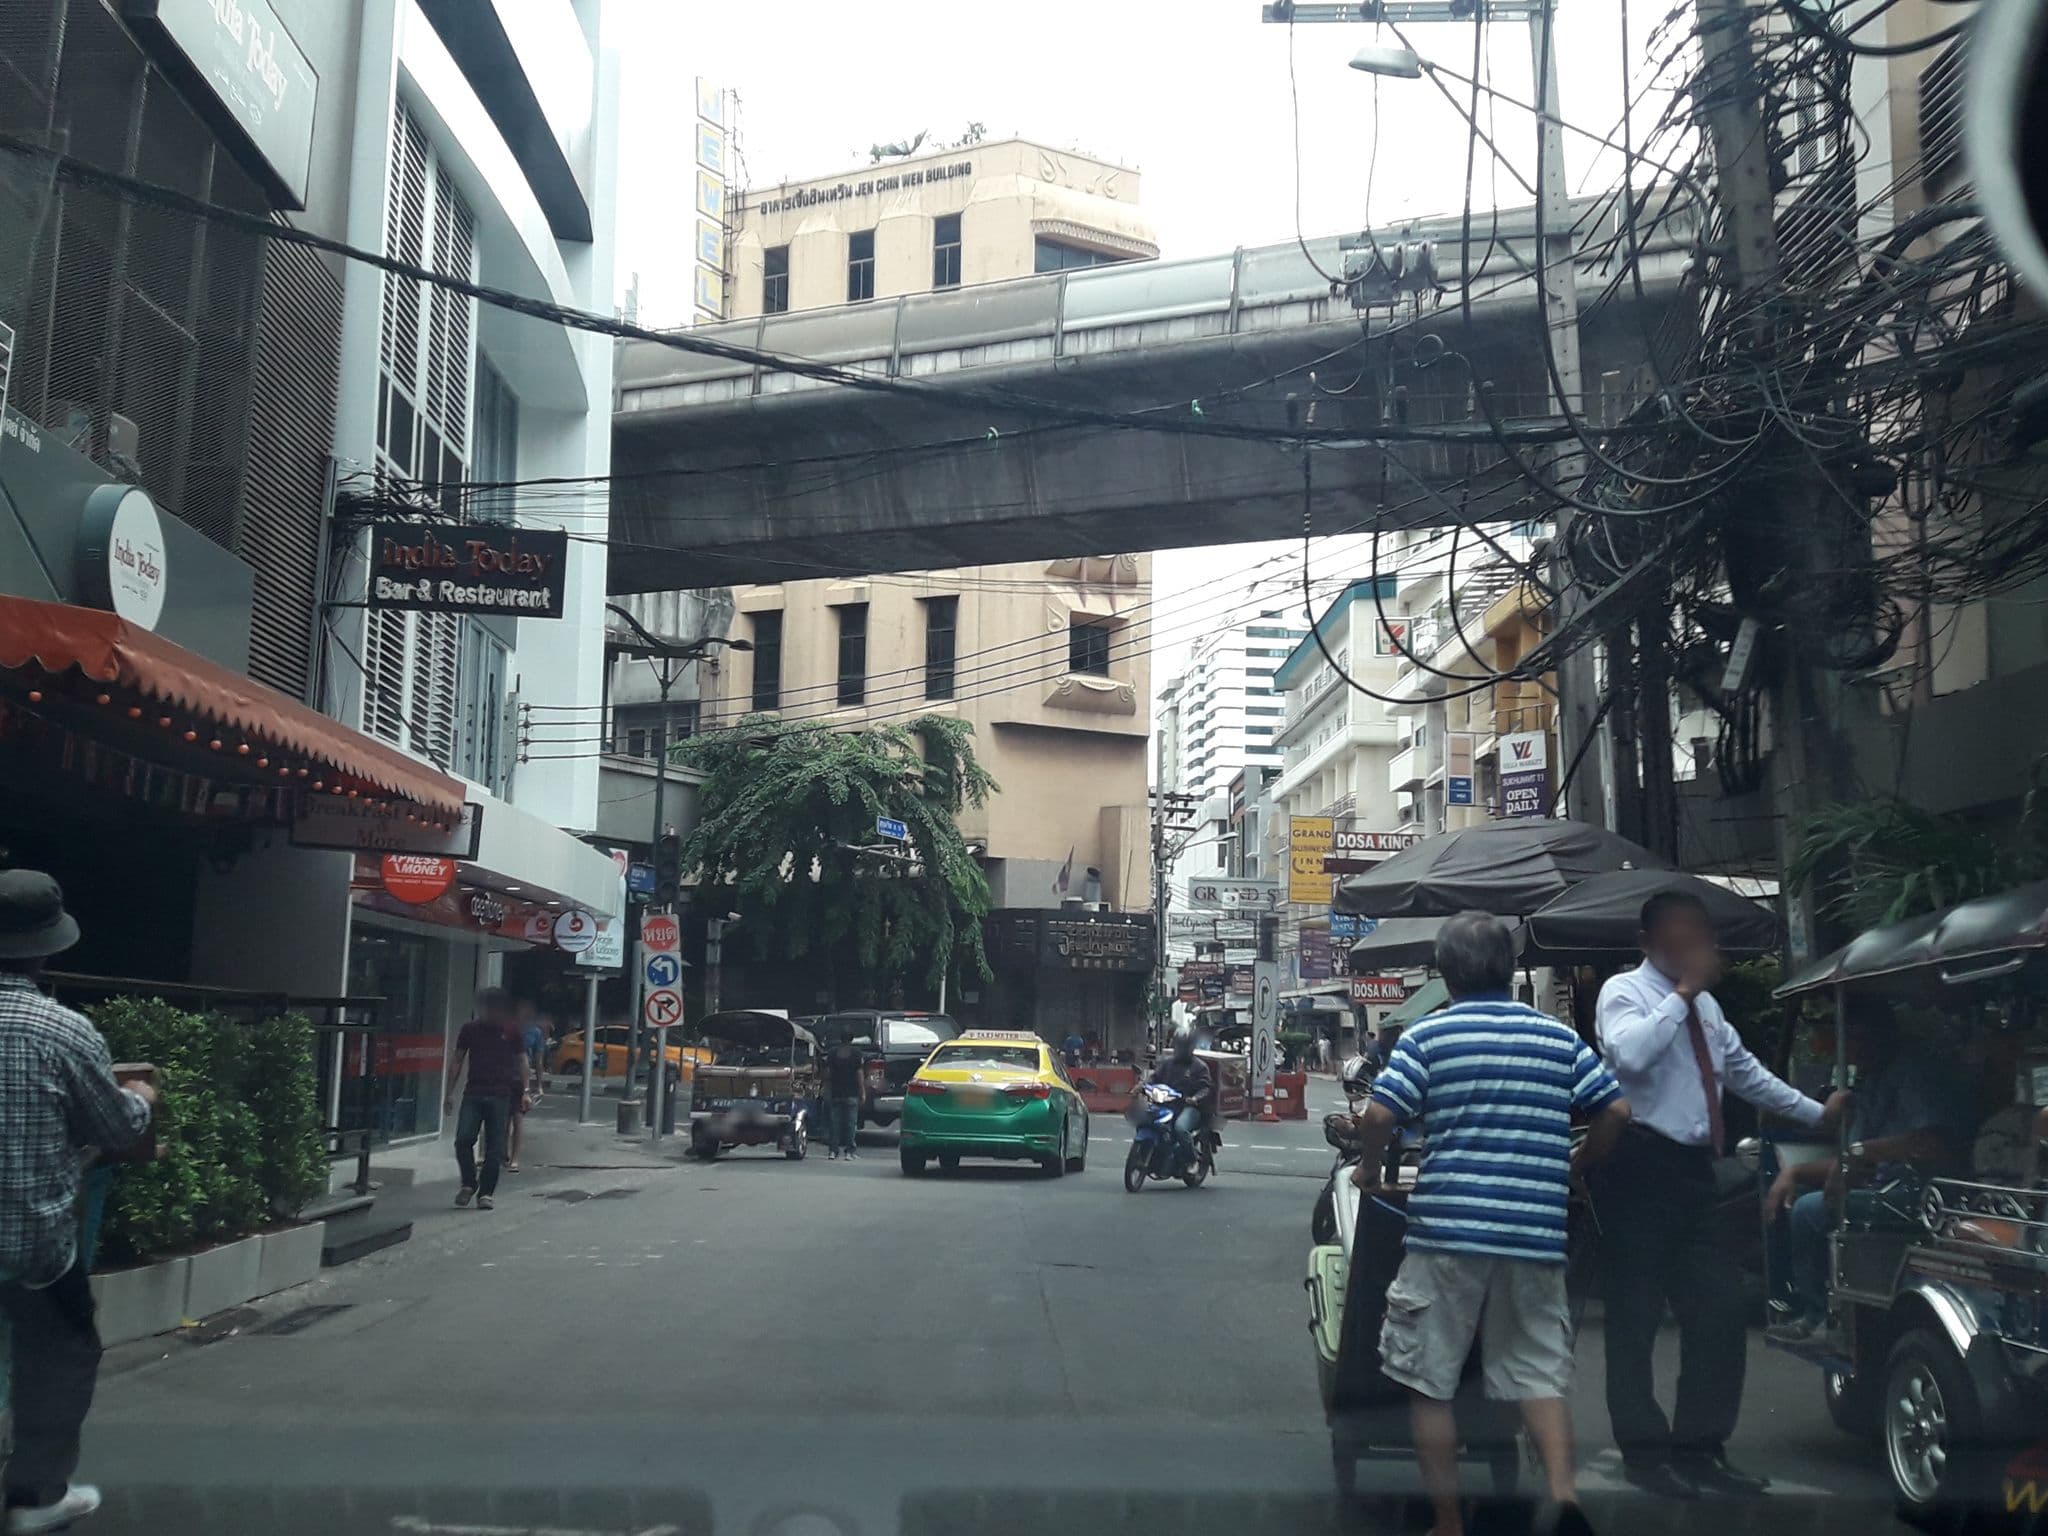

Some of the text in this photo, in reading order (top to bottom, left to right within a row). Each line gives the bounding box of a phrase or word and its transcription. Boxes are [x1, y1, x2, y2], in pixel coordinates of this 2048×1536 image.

[246, 12, 288, 112] Today
[855, 161, 972, 197] JEN CHIN WEN BUILDING
[114, 537, 160, 586] India Today
[384, 529, 552, 581] India Today
[439, 580, 551, 609] Restaurant
[1506, 787, 1538, 801] OPEN
[1505, 799, 1540, 815] DAILY
[1292, 829, 1332, 840] GRAND
[1337, 833, 1413, 850] DOSA KING
[400, 863, 448, 876] MONEY
[1299, 857, 1323, 865] INN
[643, 926, 677, 947] หยุด
[1354, 983, 1405, 998] DOSA KING
